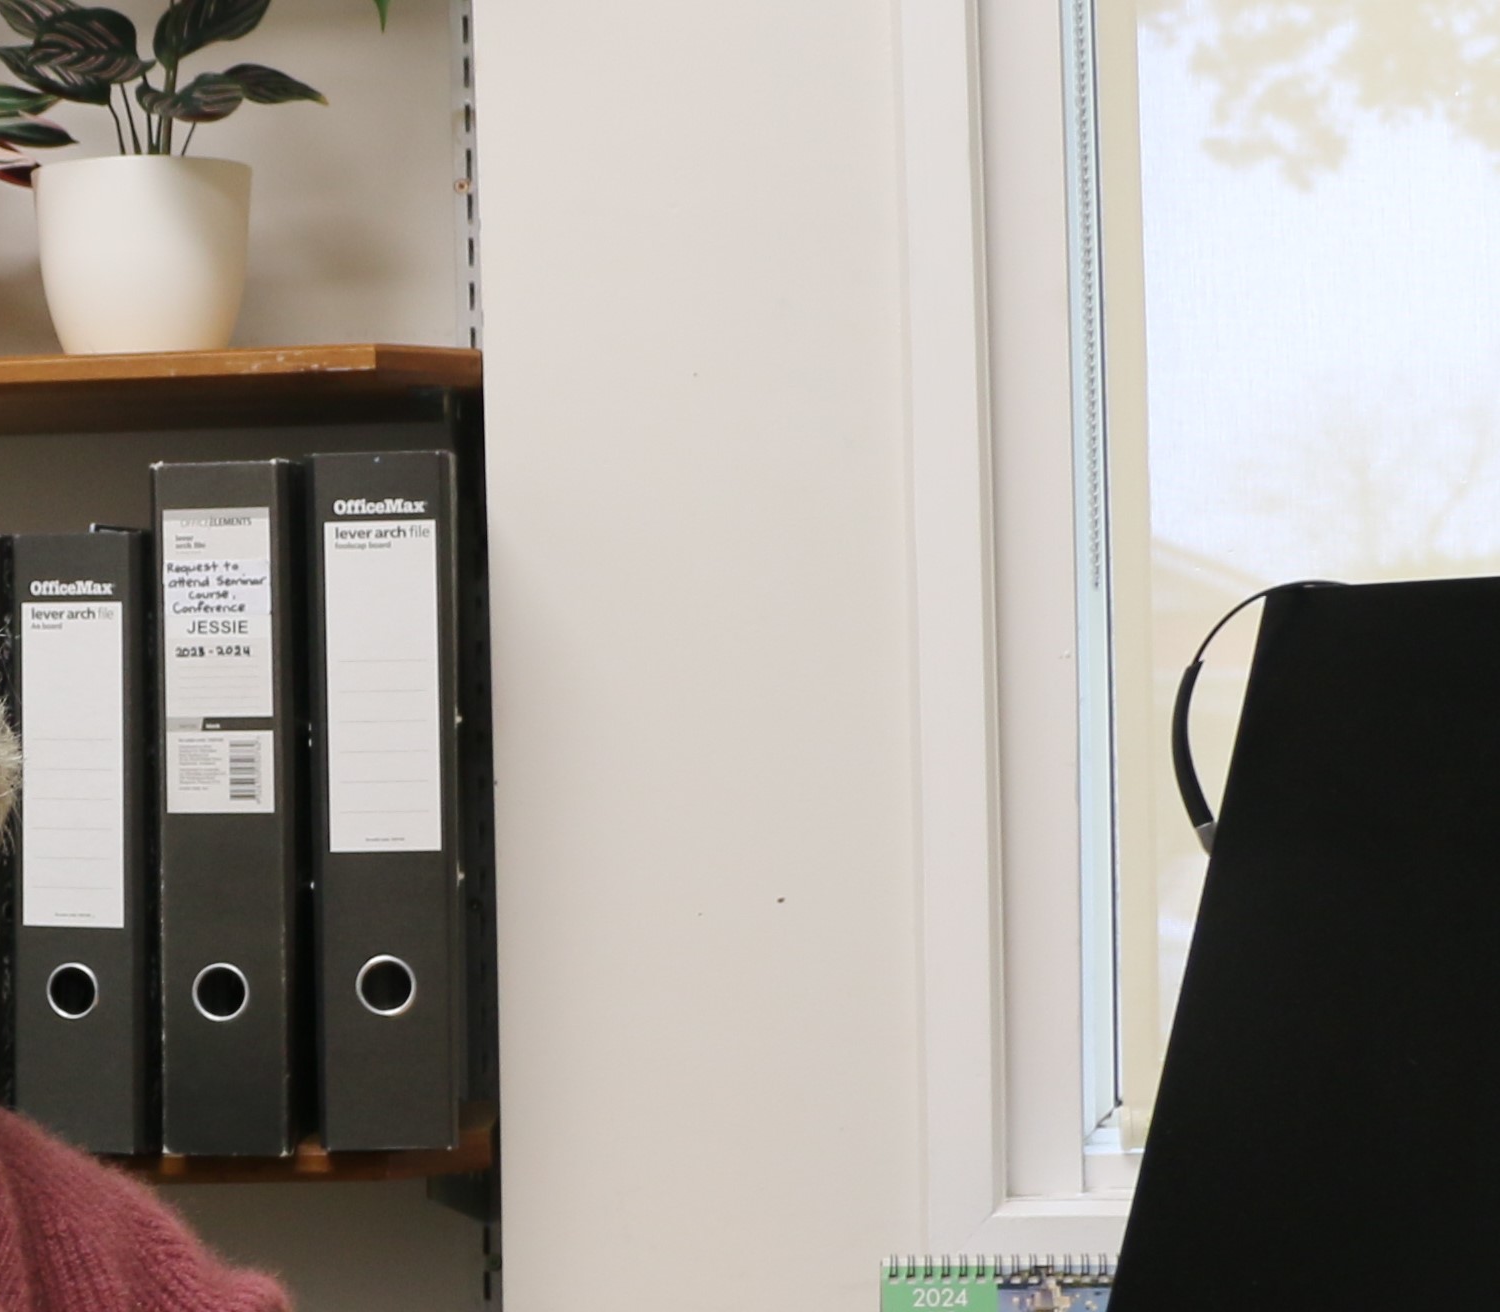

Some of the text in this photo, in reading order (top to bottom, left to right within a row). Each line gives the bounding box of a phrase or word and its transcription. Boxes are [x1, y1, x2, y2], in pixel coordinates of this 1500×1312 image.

[333, 498, 426, 515] OfficeMax
[334, 524, 431, 540] lever arch file
[166, 560, 240, 576] Request to
[29, 579, 114, 596] OfficeMax
[167, 575, 210, 588] attend
[30, 606, 65, 620] lever
[66, 606, 97, 620] arch
[172, 600, 246, 614] Conference
[186, 620, 249, 634] JESSIE
[216, 644, 251, 657] 2024
[912, 1287, 969, 1308] 2024
